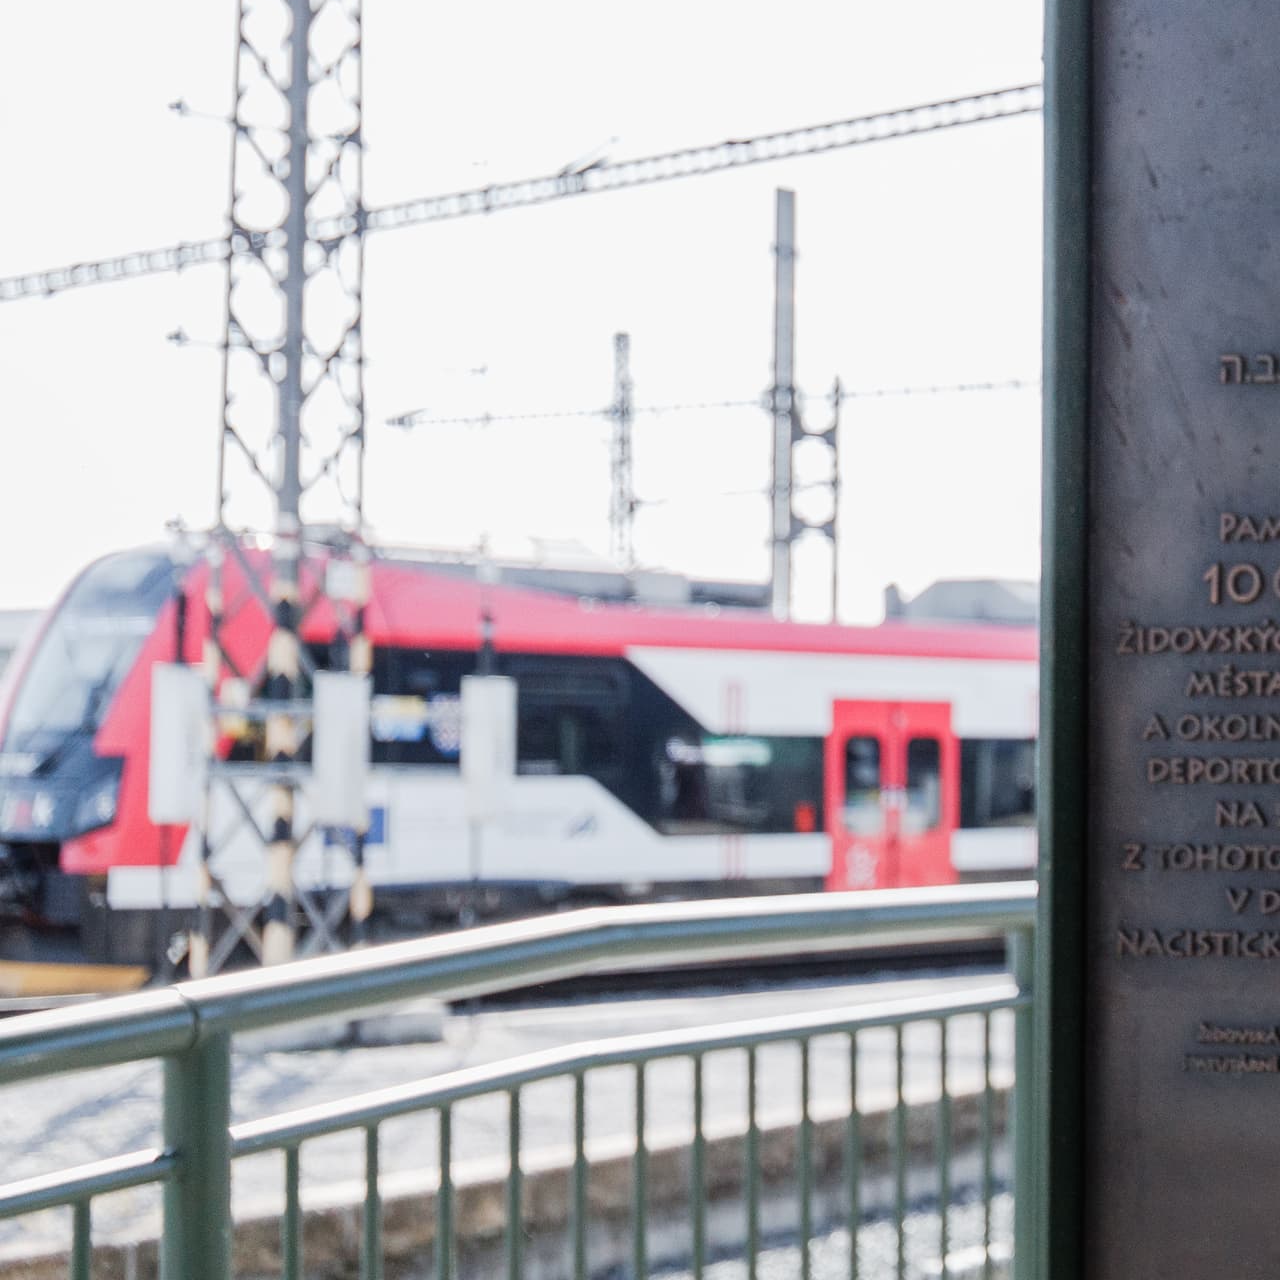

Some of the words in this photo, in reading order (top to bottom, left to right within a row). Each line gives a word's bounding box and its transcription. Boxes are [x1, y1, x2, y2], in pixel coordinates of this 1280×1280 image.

[1144, 714, 1168, 741] A
[1215, 801, 1264, 828] NA
[1121, 844, 1144, 871] Z
[1227, 888, 1250, 913] V
